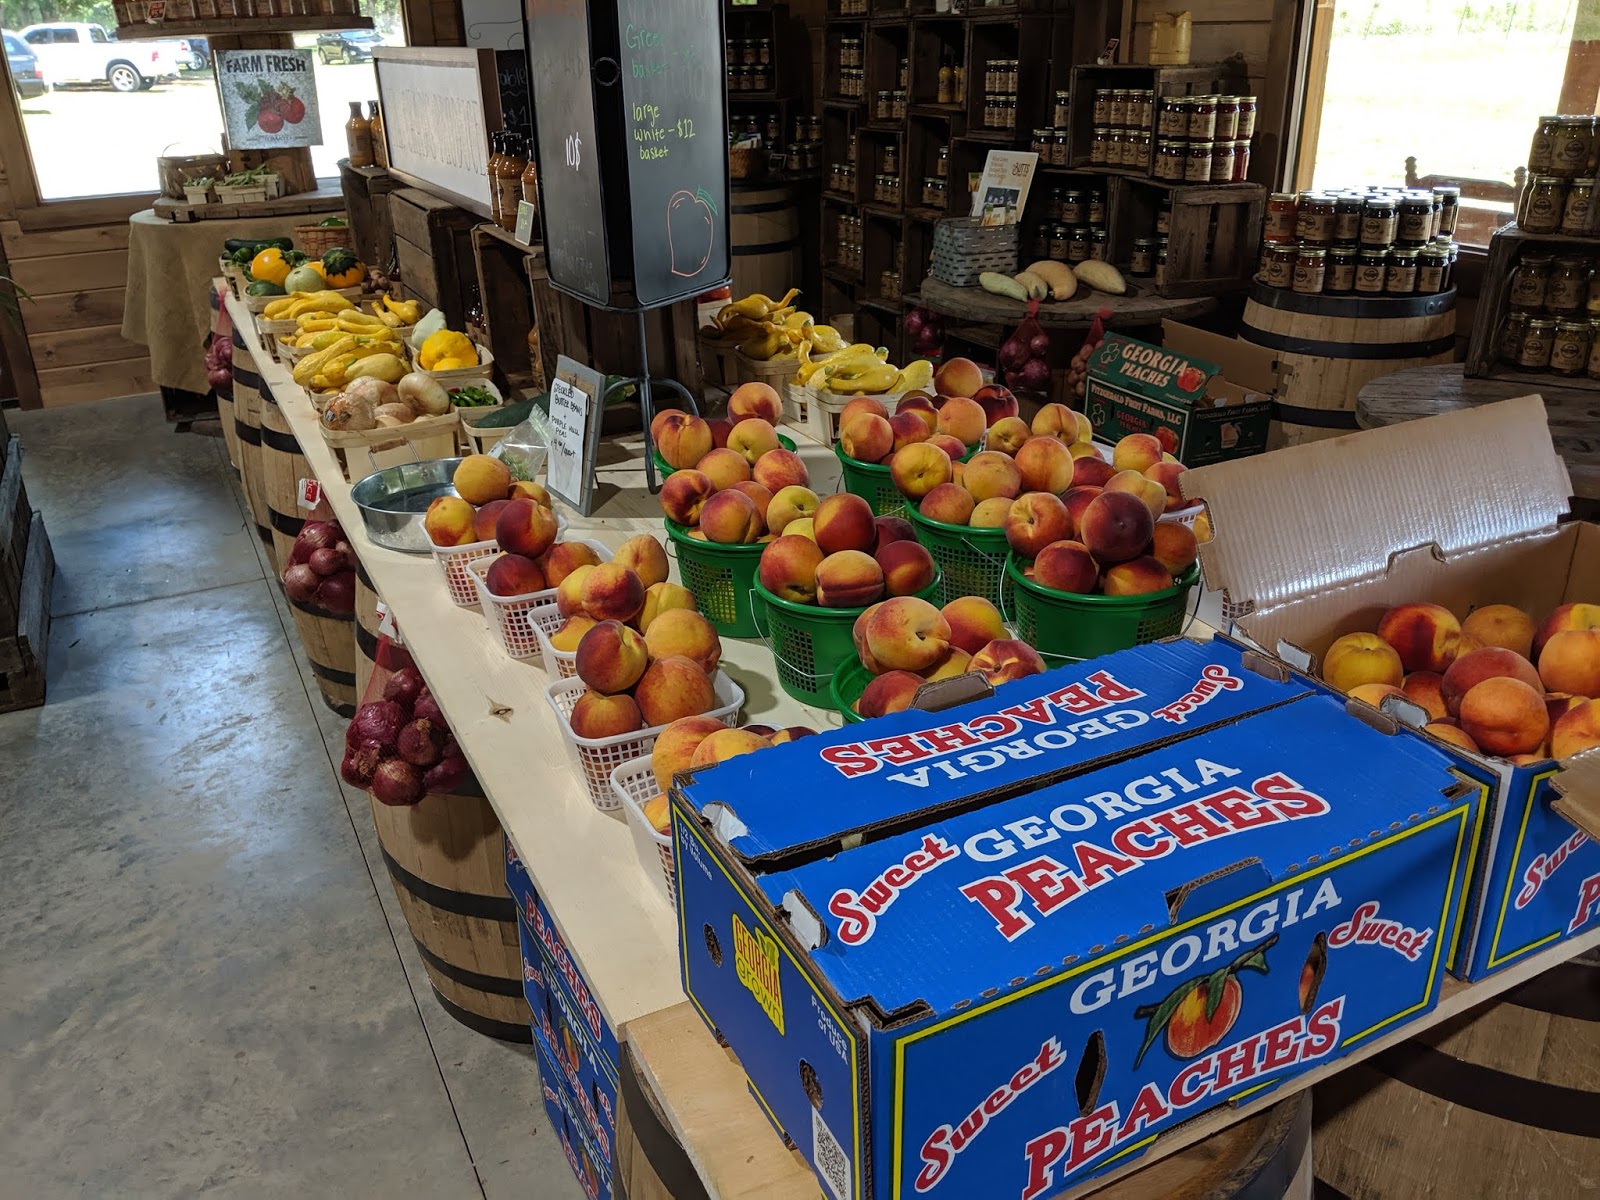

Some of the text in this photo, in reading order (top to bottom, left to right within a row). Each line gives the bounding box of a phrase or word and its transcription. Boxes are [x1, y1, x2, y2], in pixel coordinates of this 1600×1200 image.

[225, 54, 306, 73] FARM FRESH
[565, 131, 582, 171] 10$
[632, 102, 660, 127] large
[634, 127, 665, 141] white
[677, 118, 696, 138] $12
[640, 145, 669, 160] basket
[1119, 361, 1171, 388] PEACHES
[1121, 343, 1189, 377] GEORGIA
[1091, 383, 1124, 404] FITZGERALD
[1167, 411, 1182, 425] LLC
[819, 669, 1148, 779] PEACHES
[1151, 664, 1244, 725] Sweet
[886, 708, 1151, 788] GEORGIA
[963, 756, 1242, 863] GEORGIA
[828, 832, 962, 946] Sweet
[959, 771, 1332, 943] PEACHES
[1515, 828, 1590, 910] Swe
[525, 890, 601, 1043] PEACHES
[735, 917, 781, 1008] GEORGIA
[1069, 877, 1343, 1016] GEORGIA
[1328, 901, 1433, 962] Sweet
[541, 960, 599, 1076] GEORGIA
[737, 957, 782, 1026] grown
[811, 994, 848, 1050] Produce
[818, 1018, 849, 1065] of USA
[541, 1008, 611, 1164] PEACHES
[915, 1035, 1067, 1194] Sweet
[1021, 996, 1346, 1200] PEACHES
